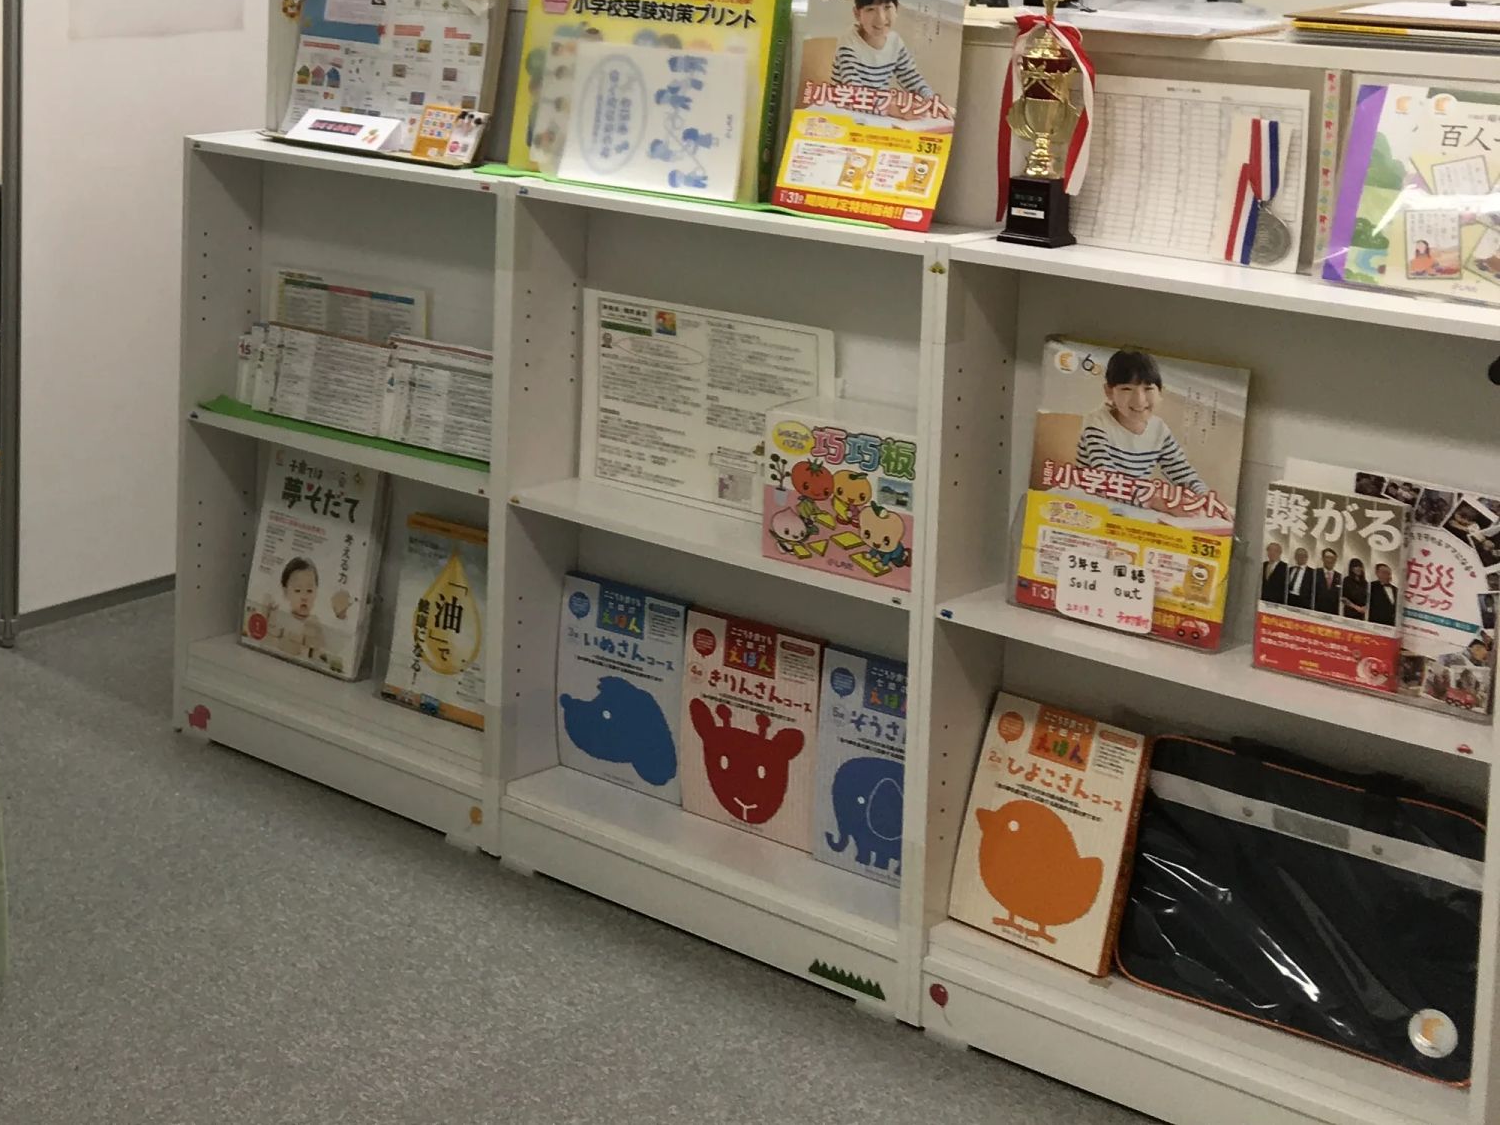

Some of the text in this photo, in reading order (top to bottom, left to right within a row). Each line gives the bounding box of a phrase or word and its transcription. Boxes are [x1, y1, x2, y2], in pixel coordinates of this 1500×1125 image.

[814, 84, 948, 119] 小学生プリント
[1440, 124, 1500, 151] 百人
[289, 459, 323, 480] 子育ては
[811, 426, 917, 481] 巧巧板
[281, 475, 360, 524] 夢そだて
[1055, 463, 1227, 517] 小学生プリント
[1266, 490, 1403, 552] 繋がる
[1068, 554, 1101, 573] 3年生
[1069, 577, 1097, 591] Sold
[428, 581, 468, 662] 「油」で
[583, 632, 675, 672] いぬさんコース
[728, 645, 772, 672] えほん
[708, 669, 812, 713] きりんさんコース
[870, 687, 907, 713] えほ
[1035, 732, 1083, 764] えほん
[1007, 756, 1123, 813] ひよこさんコース
